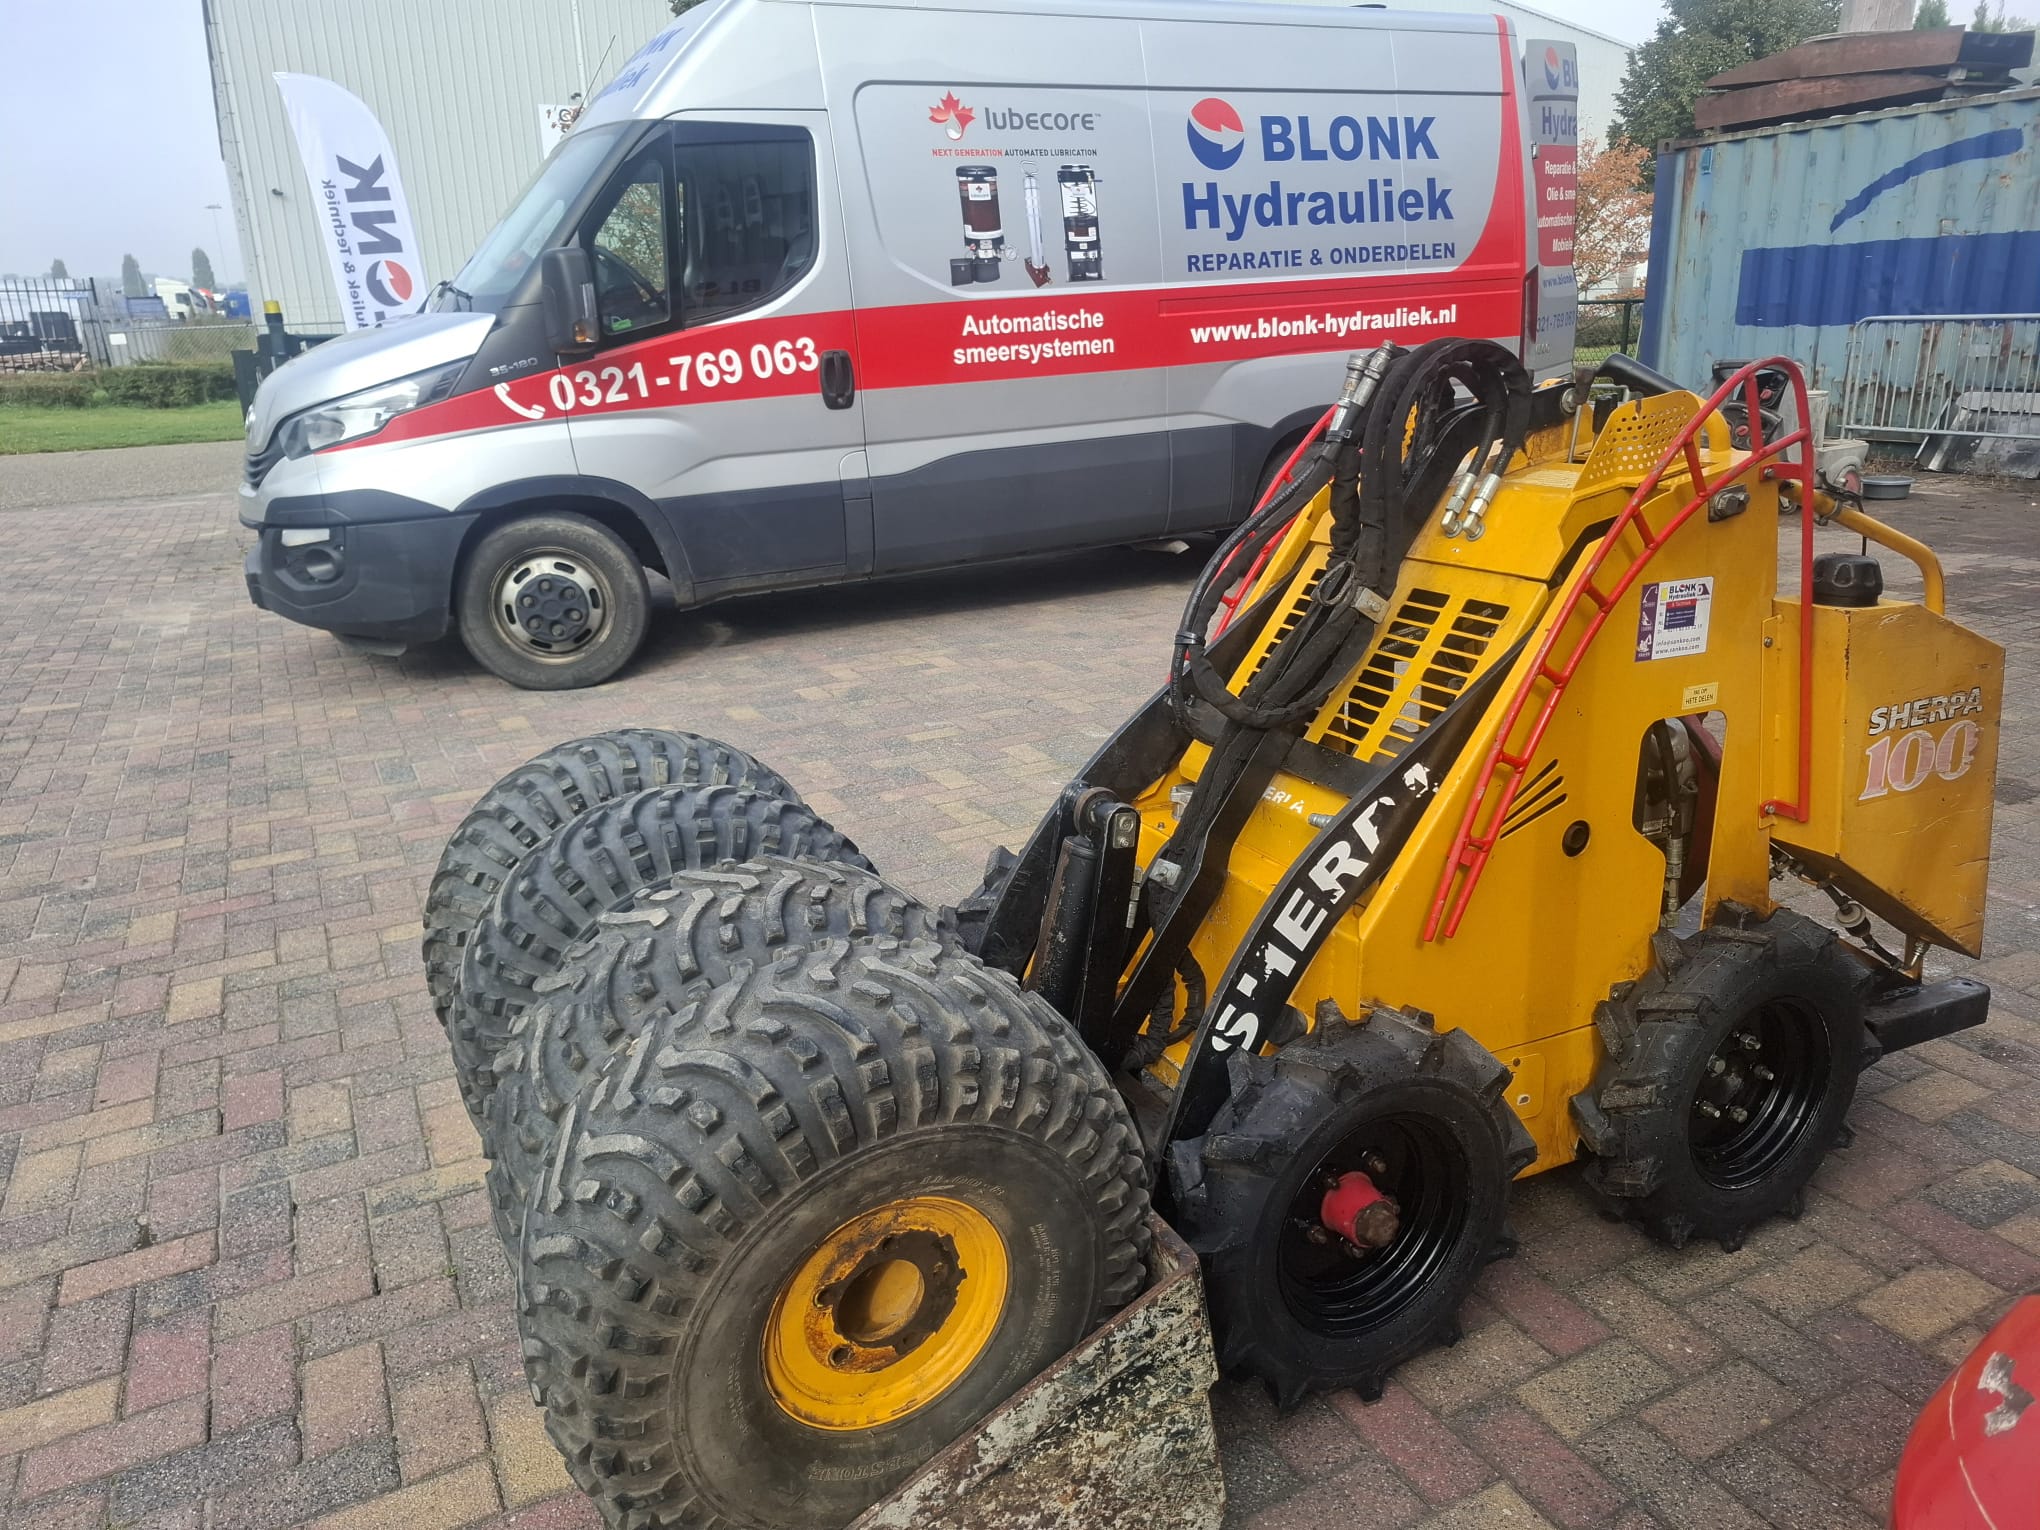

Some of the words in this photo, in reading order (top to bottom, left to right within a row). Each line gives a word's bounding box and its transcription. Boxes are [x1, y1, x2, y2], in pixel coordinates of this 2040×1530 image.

[932, 148, 952, 157] NEXT
[954, 148, 1003, 157] GENERATION
[1004, 148, 1049, 157] AUTOMATED
[1051, 148, 1097, 157] LUBRICATION
[1260, 115, 1440, 162] BLONK
[1545, 160, 1571, 178] Reparatie
[1546, 187, 1558, 201] Olie
[1182, 177, 1454, 242] Hydrauliek
[1537, 212, 1573, 228] utomatische
[1187, 249, 1302, 273] REPARATIE
[1309, 249, 1323, 267] &
[1330, 242, 1456, 265] ONDERDELEN
[962, 308, 1105, 337] Automatische
[1190, 304, 1457, 344] www.blonk-hydrauliek.nl
[751, 337, 819, 379] 063
[953, 336, 1115, 366] smeersystemen
[1669, 583, 1696, 594] BLONK
[1868, 686, 1983, 736] SHERPA
[1859, 720, 1979, 800] 100
